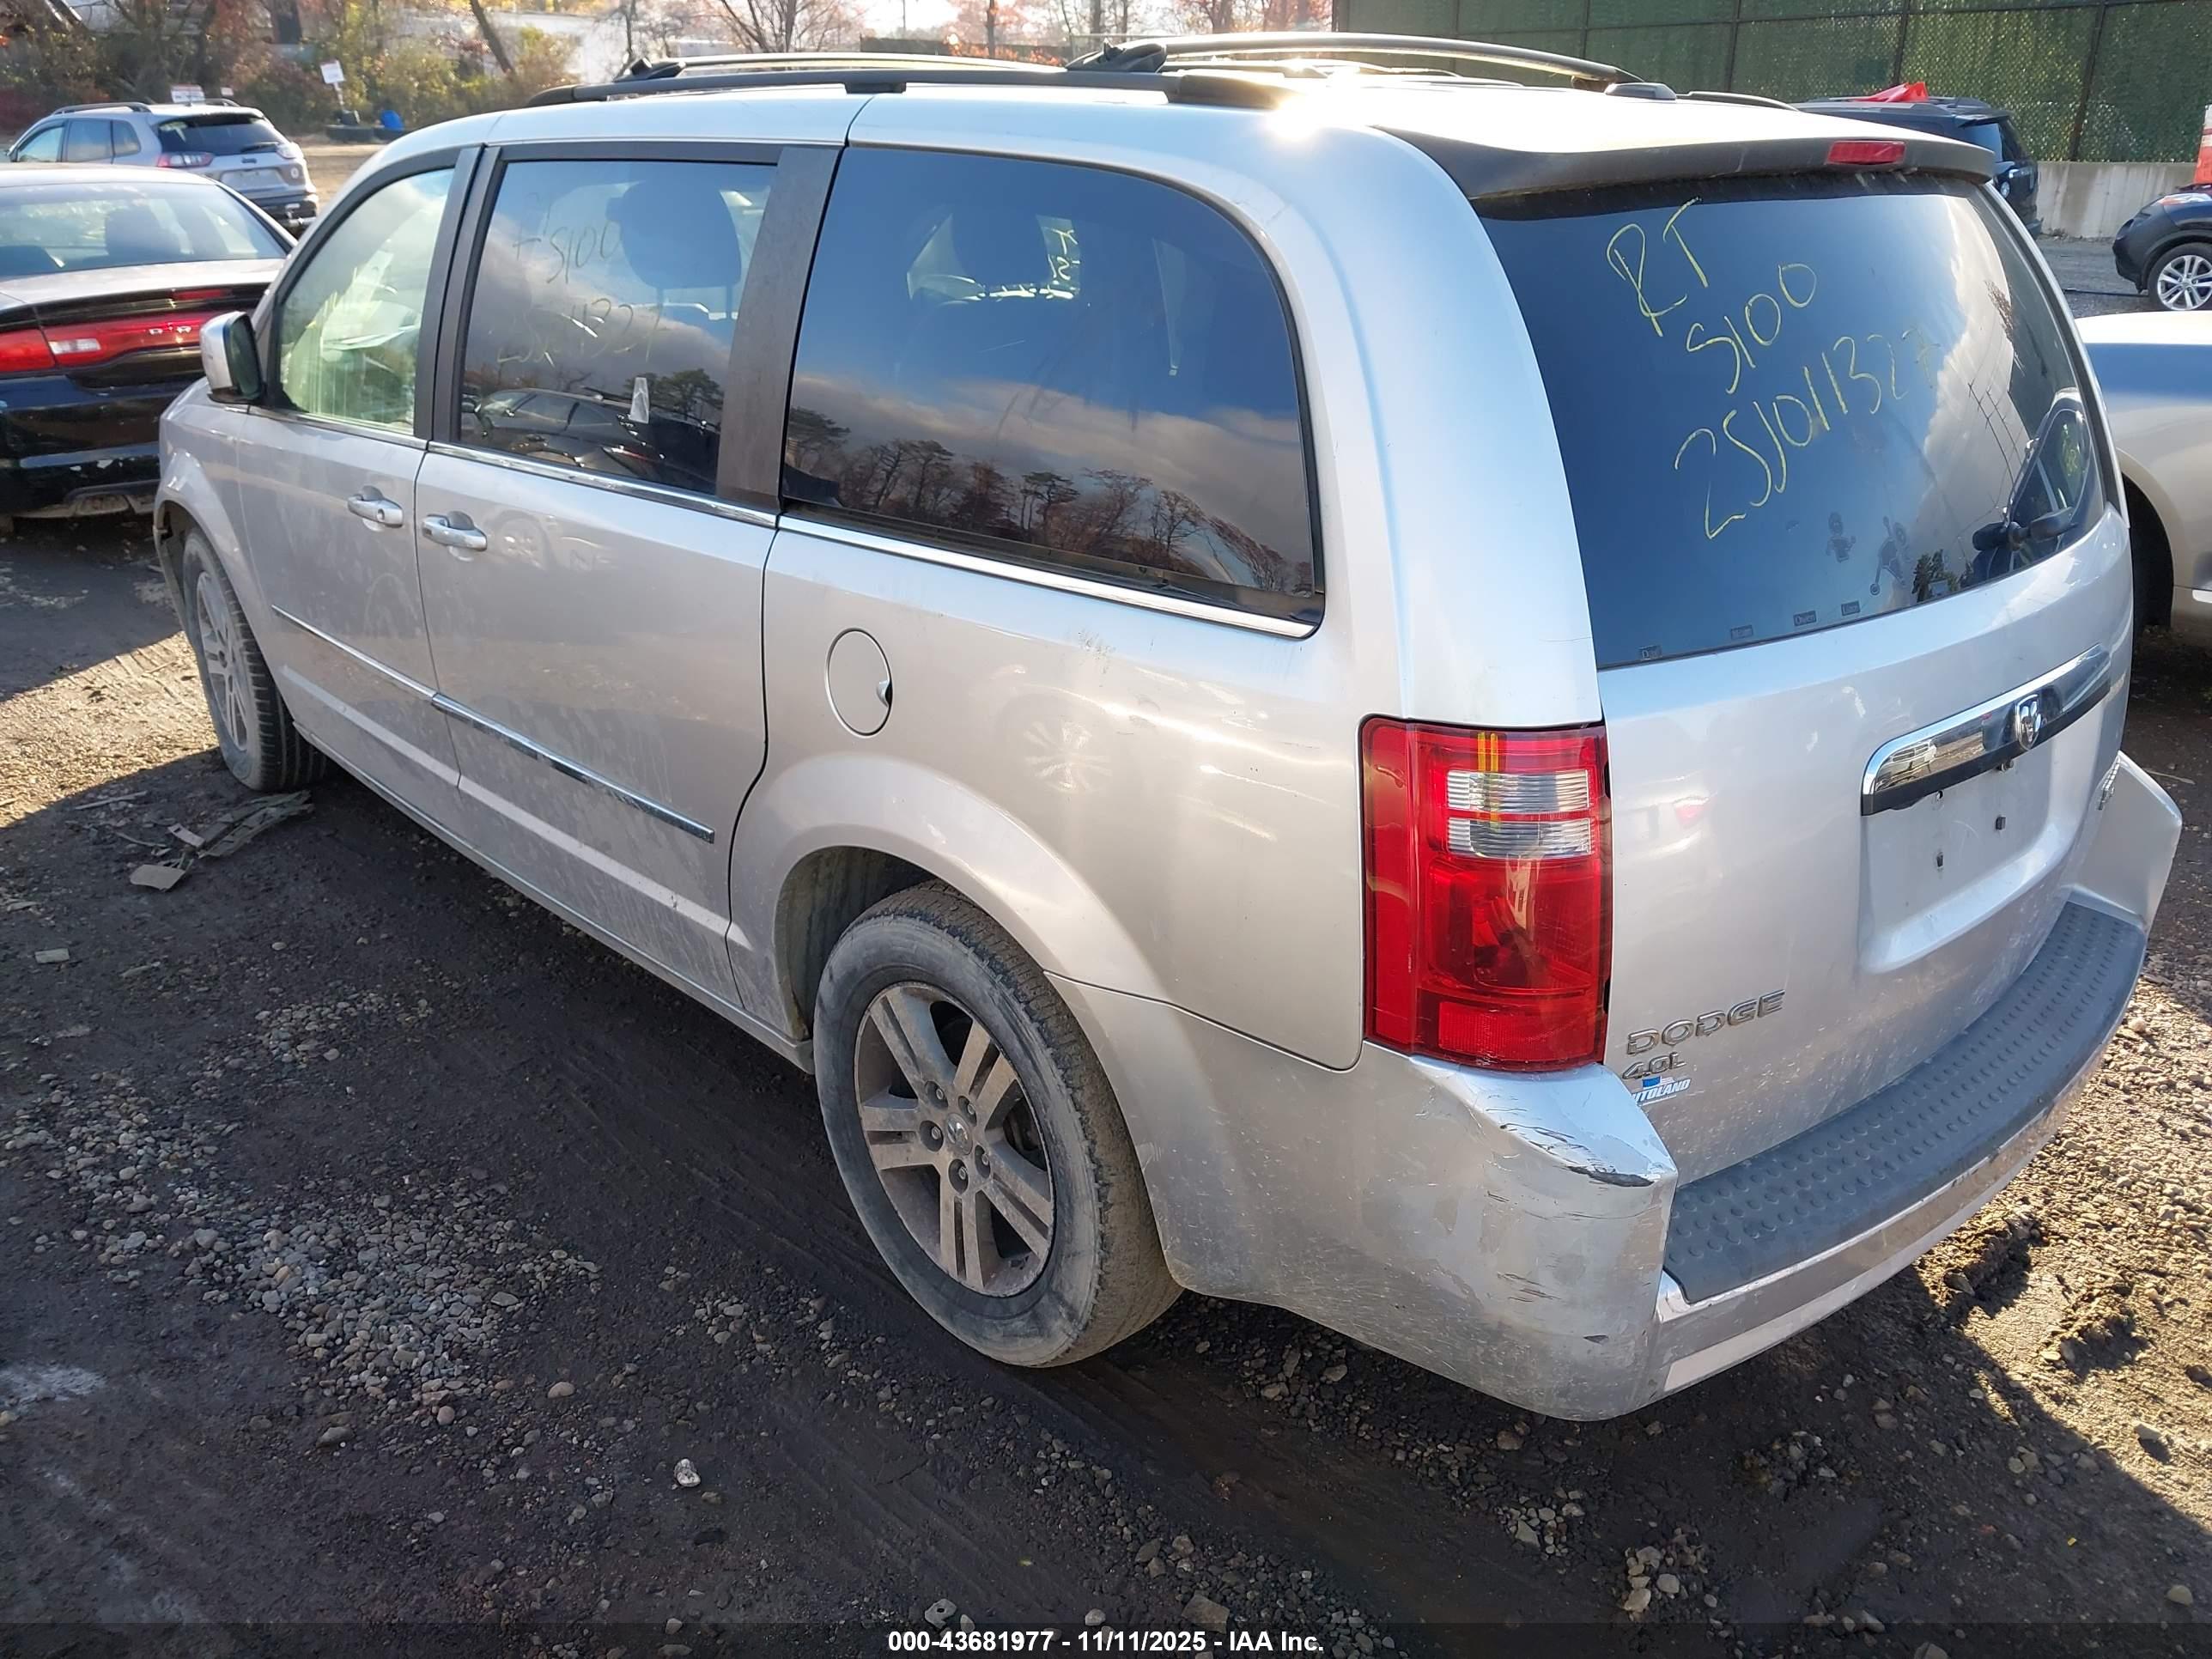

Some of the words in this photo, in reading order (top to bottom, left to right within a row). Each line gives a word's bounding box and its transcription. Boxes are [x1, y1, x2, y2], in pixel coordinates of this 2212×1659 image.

[1606, 196, 1709, 337] RT
[1626, 988, 1786, 1055] DODGE
[1621, 1051, 1686, 1079] 4.0L
[1632, 1079, 1691, 1103] UTOLAND
